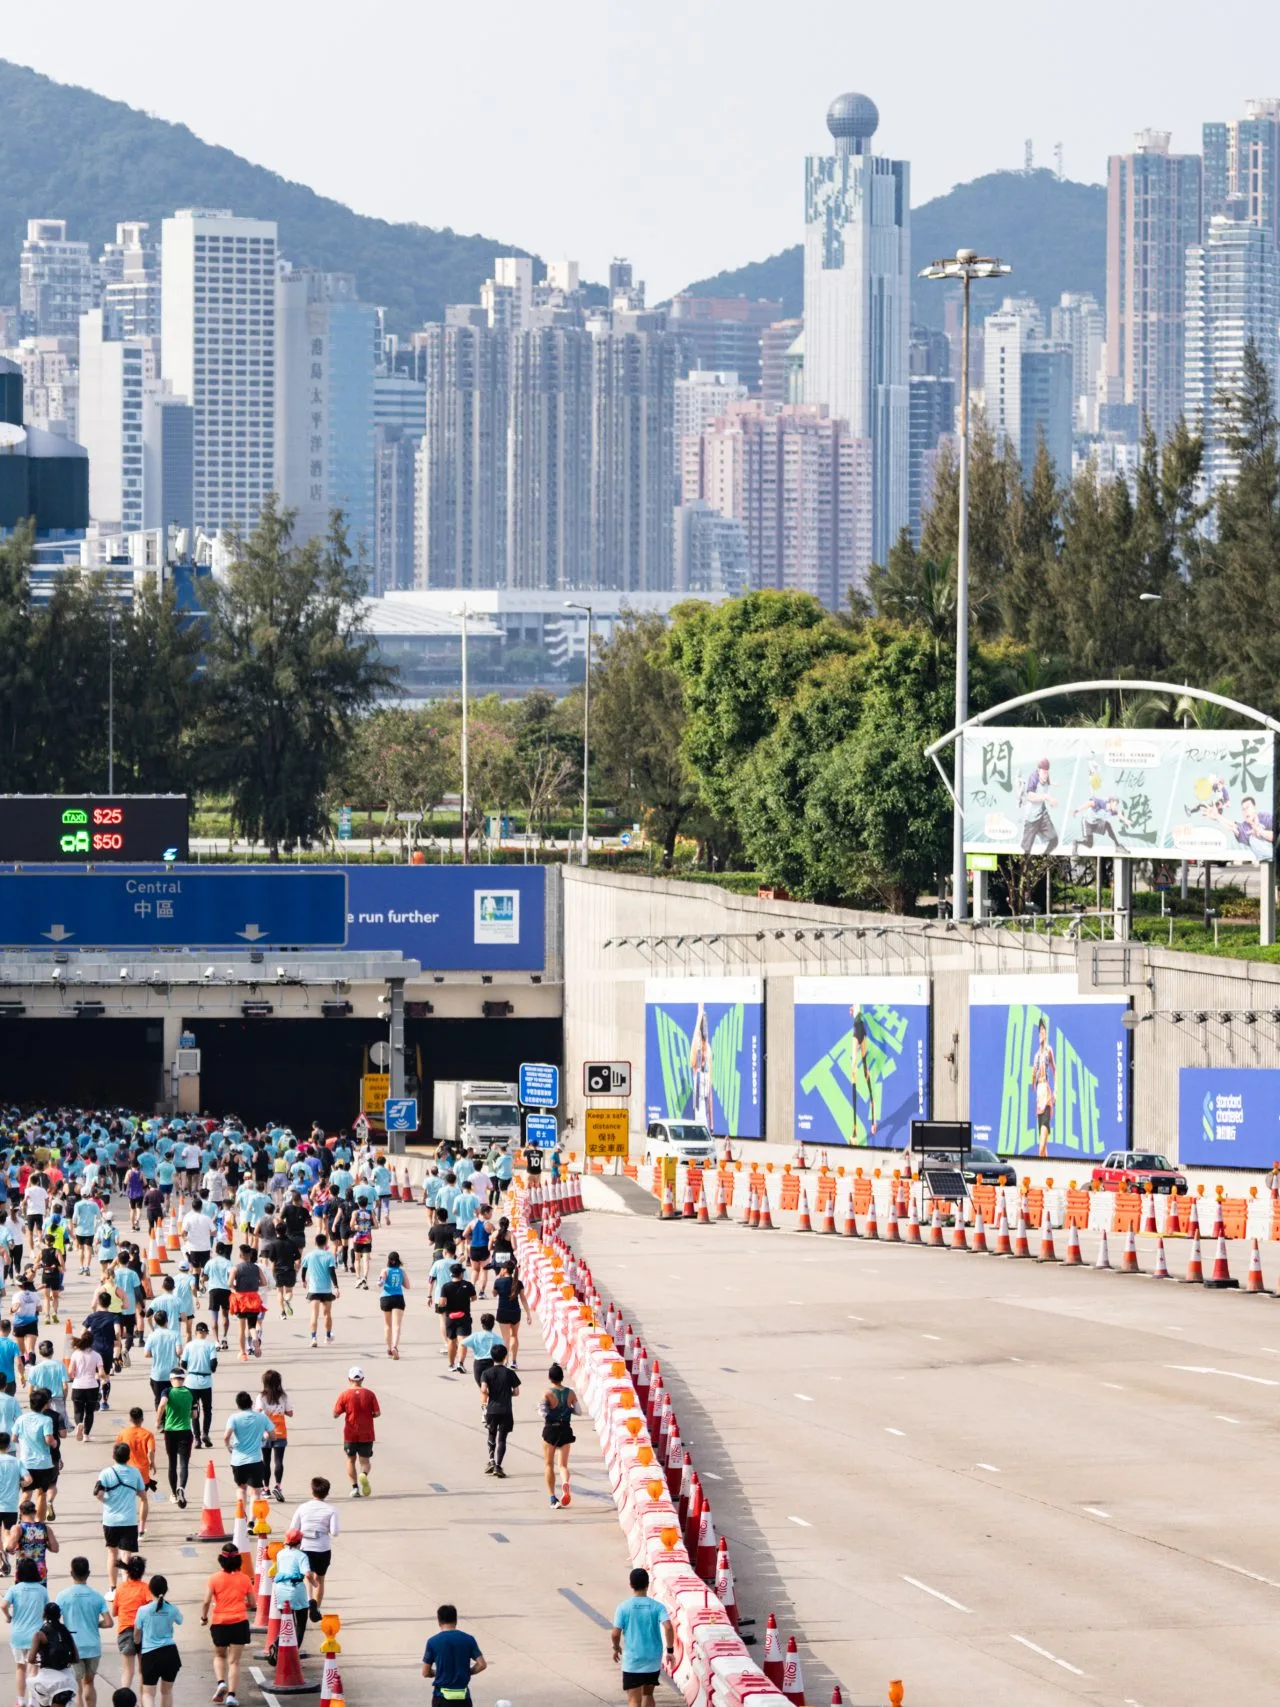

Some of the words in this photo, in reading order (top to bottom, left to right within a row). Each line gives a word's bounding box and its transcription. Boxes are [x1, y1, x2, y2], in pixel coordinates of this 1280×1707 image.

[92, 808, 123, 825] $25
[92, 833, 123, 850] $50
[125, 879, 182, 894] Central
[134, 899, 174, 919] 中區
[358, 912, 384, 924] run
[387, 909, 440, 924] further
[530, 1157, 540, 1167] 10
